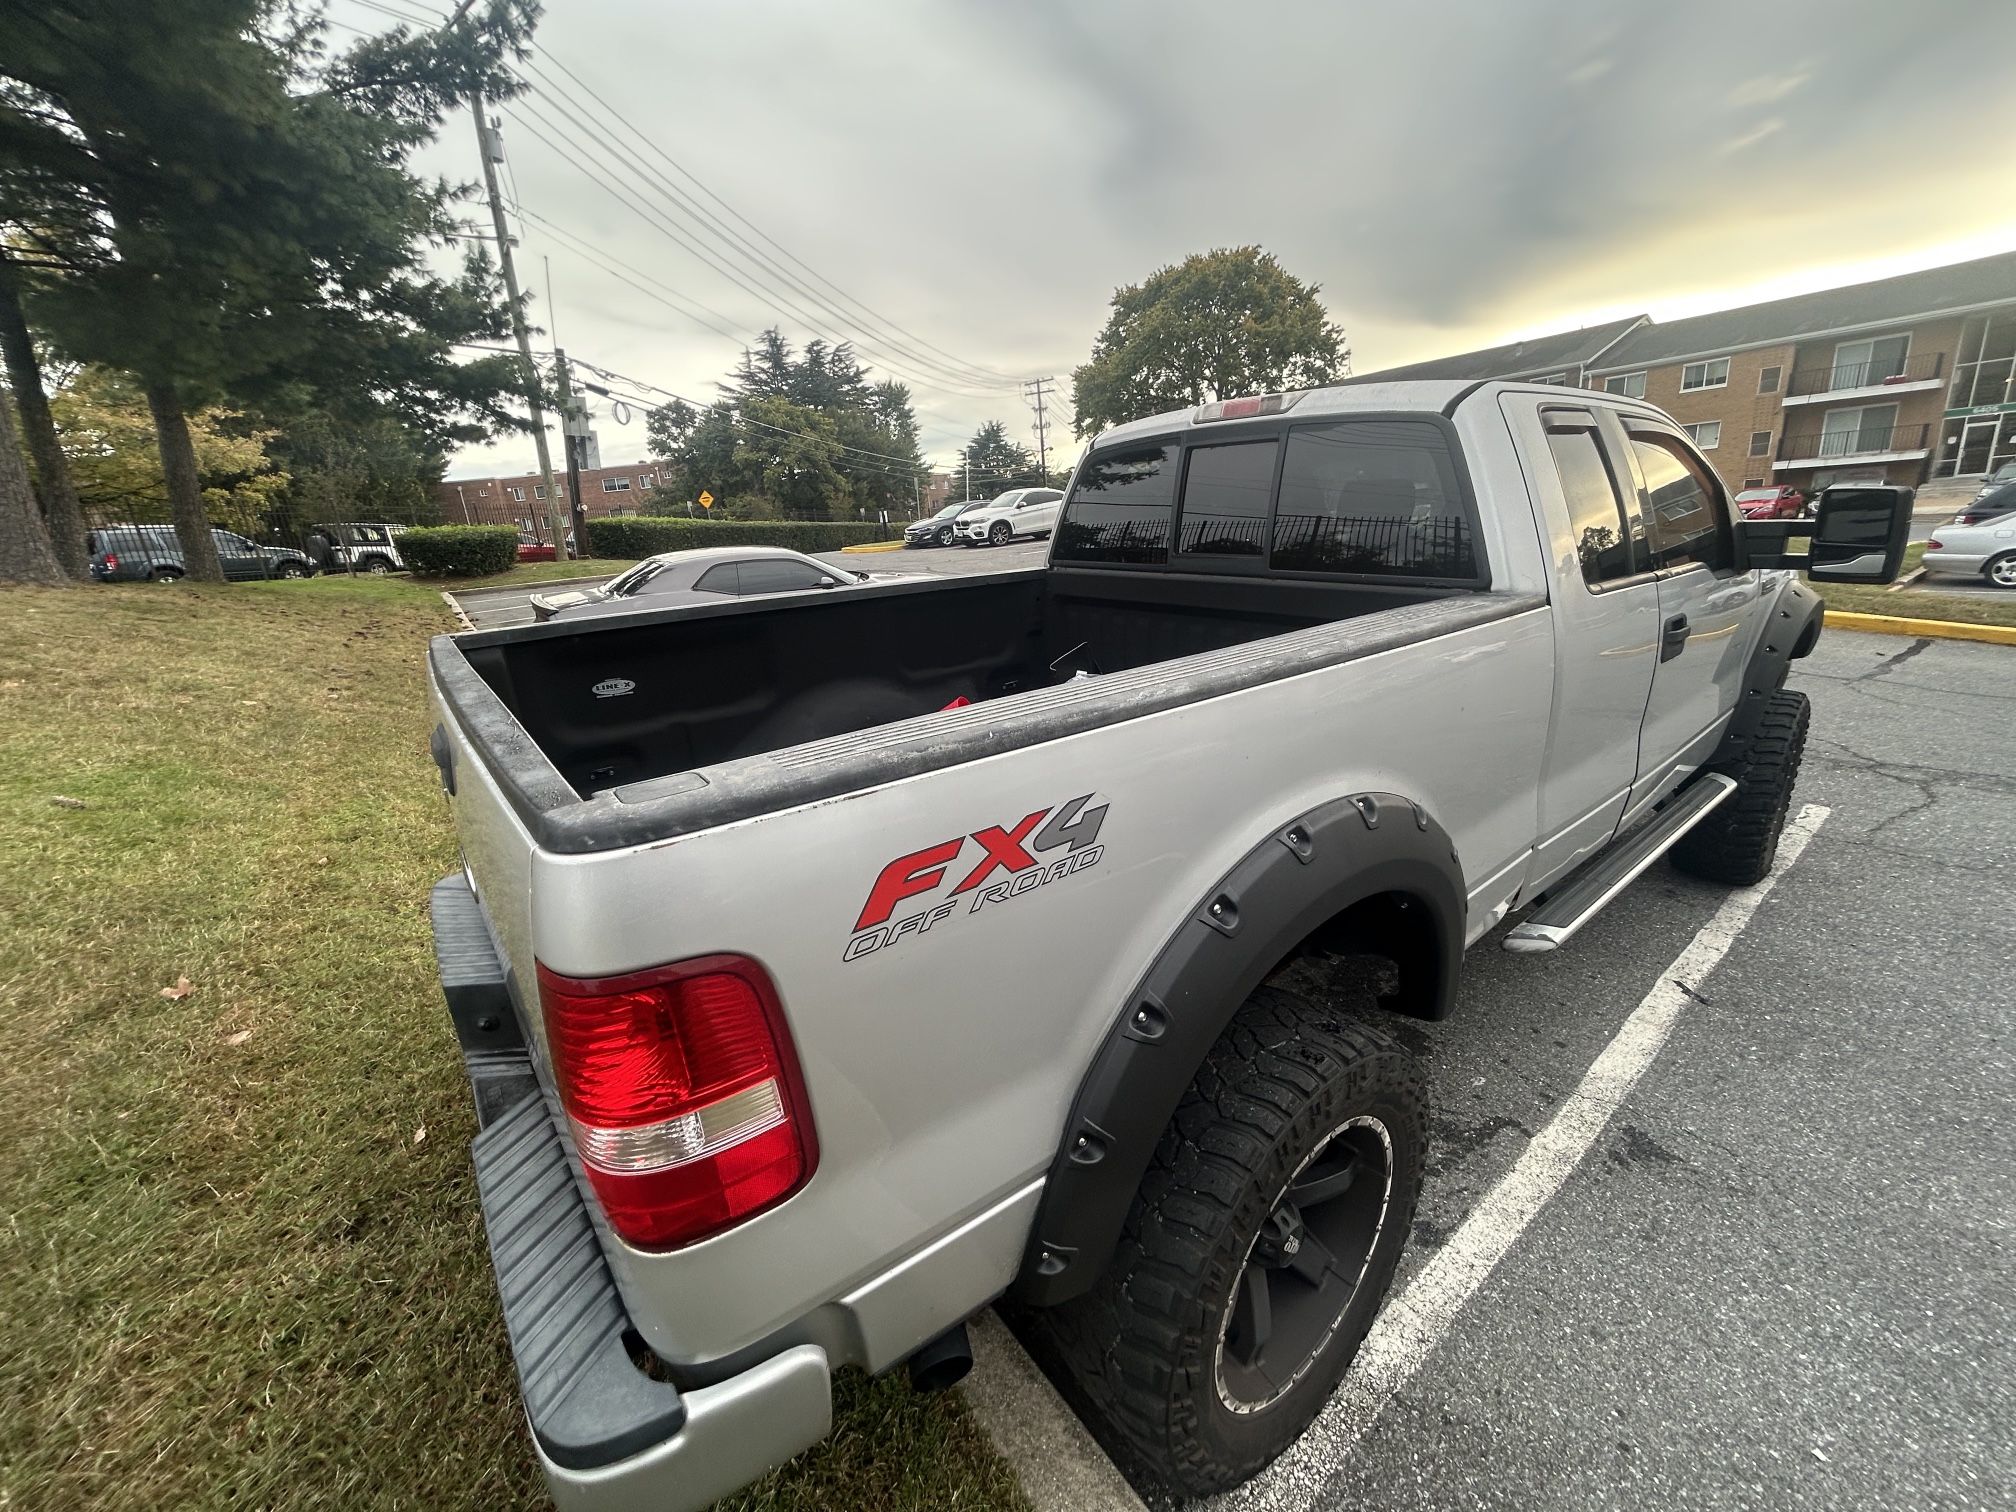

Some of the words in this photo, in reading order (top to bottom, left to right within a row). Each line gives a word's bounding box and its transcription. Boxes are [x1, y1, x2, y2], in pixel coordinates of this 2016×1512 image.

[843, 899, 958, 962] OFF
[969, 845, 1105, 913] ROAD
[852, 792, 1110, 933] FX4
